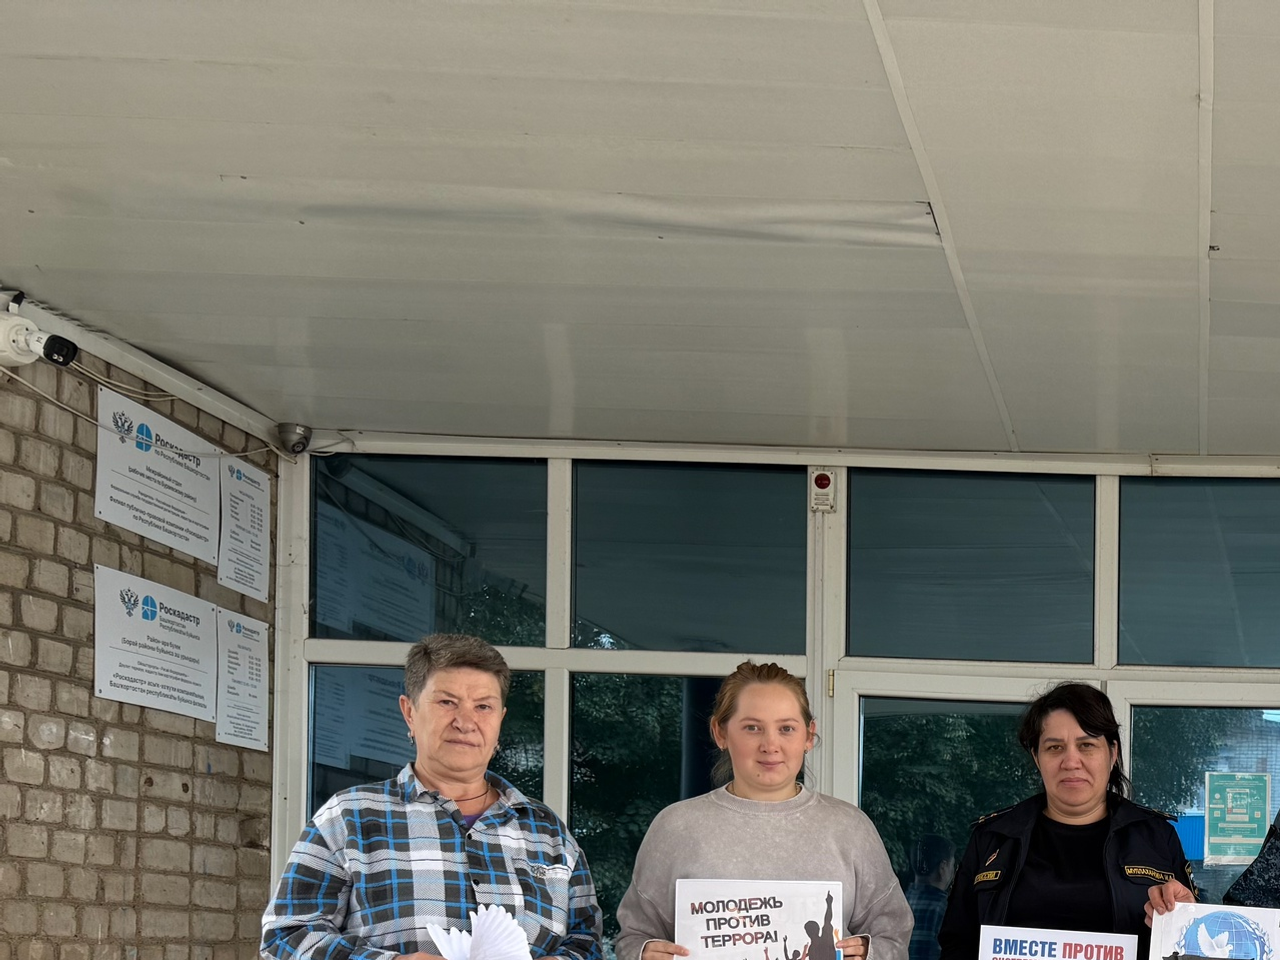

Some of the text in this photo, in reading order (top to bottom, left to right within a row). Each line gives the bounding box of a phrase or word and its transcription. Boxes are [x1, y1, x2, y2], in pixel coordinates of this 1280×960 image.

[159, 601, 200, 627] Роскадастр
[690, 897, 783, 915] МОЛОДЕЖЬ
[705, 915, 771, 931] ПРОТИВ
[701, 930, 778, 948] ТЕРРОРА!
[992, 938, 1057, 958] ВМЕСТЕ
